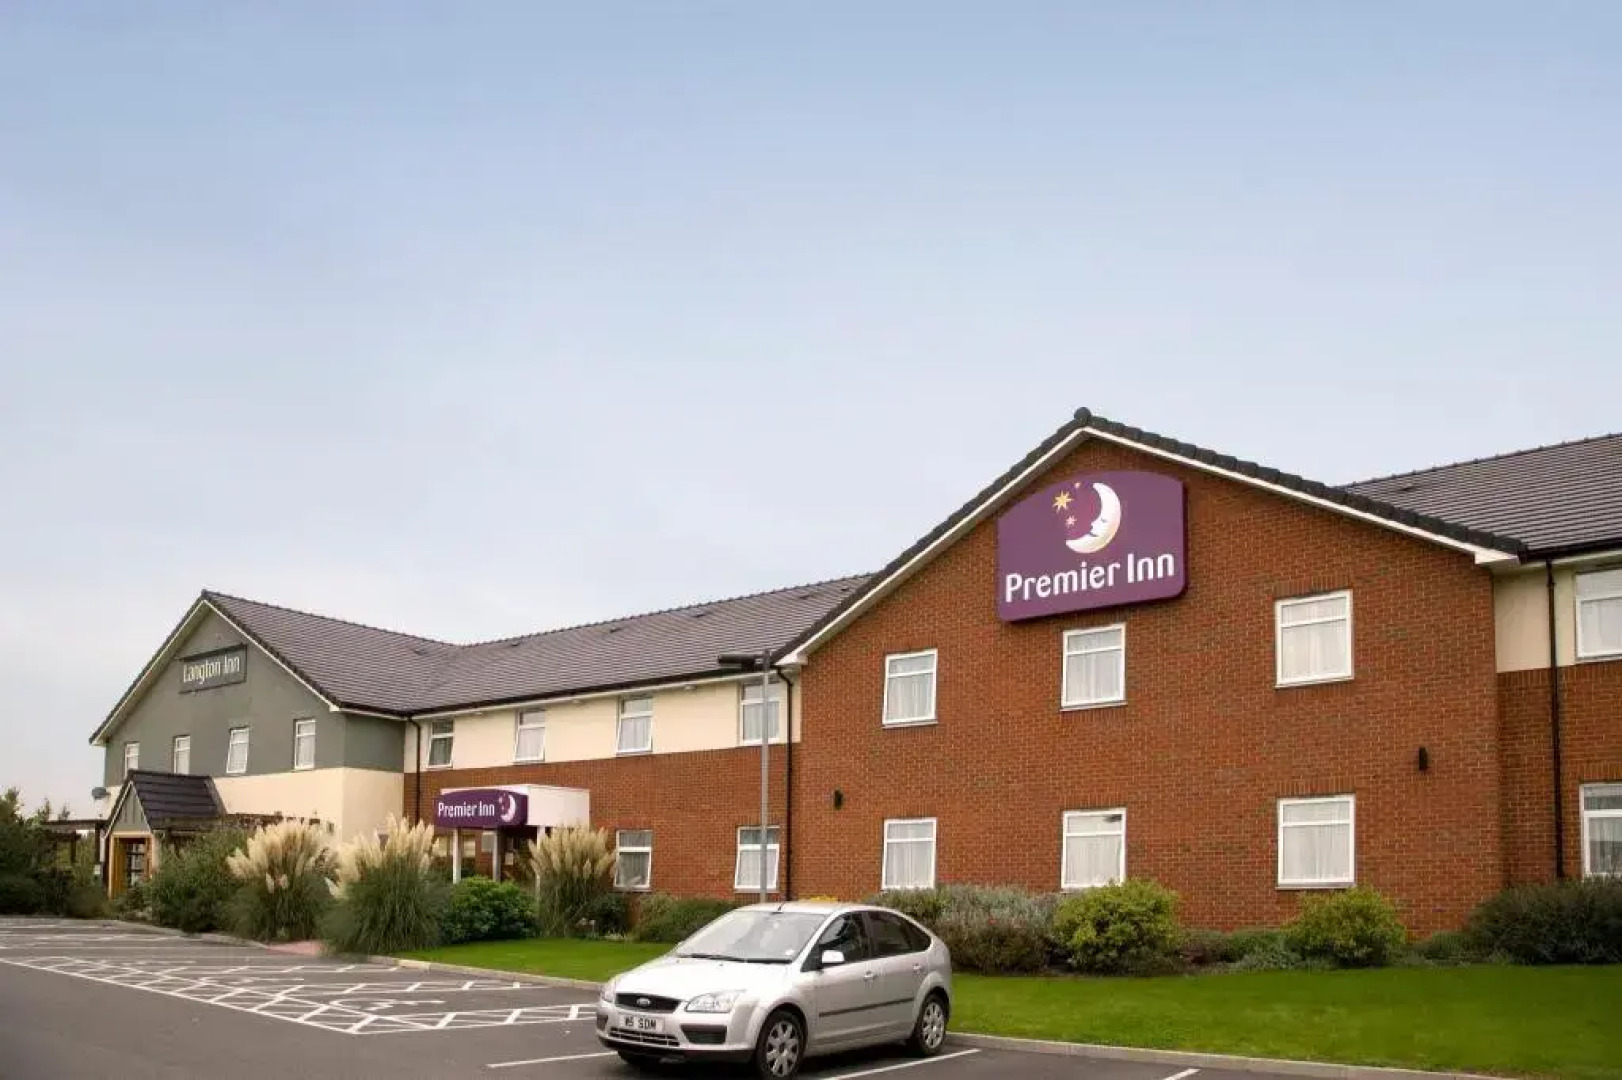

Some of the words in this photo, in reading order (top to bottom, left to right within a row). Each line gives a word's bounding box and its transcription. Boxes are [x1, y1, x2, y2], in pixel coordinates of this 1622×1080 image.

[1005, 561, 1120, 602] Premier
[1127, 553, 1174, 583] Inn
[183, 659, 221, 684] Langton
[223, 653, 240, 673] Inn
[438, 801, 477, 817] Premier
[479, 800, 495, 816] Inn
